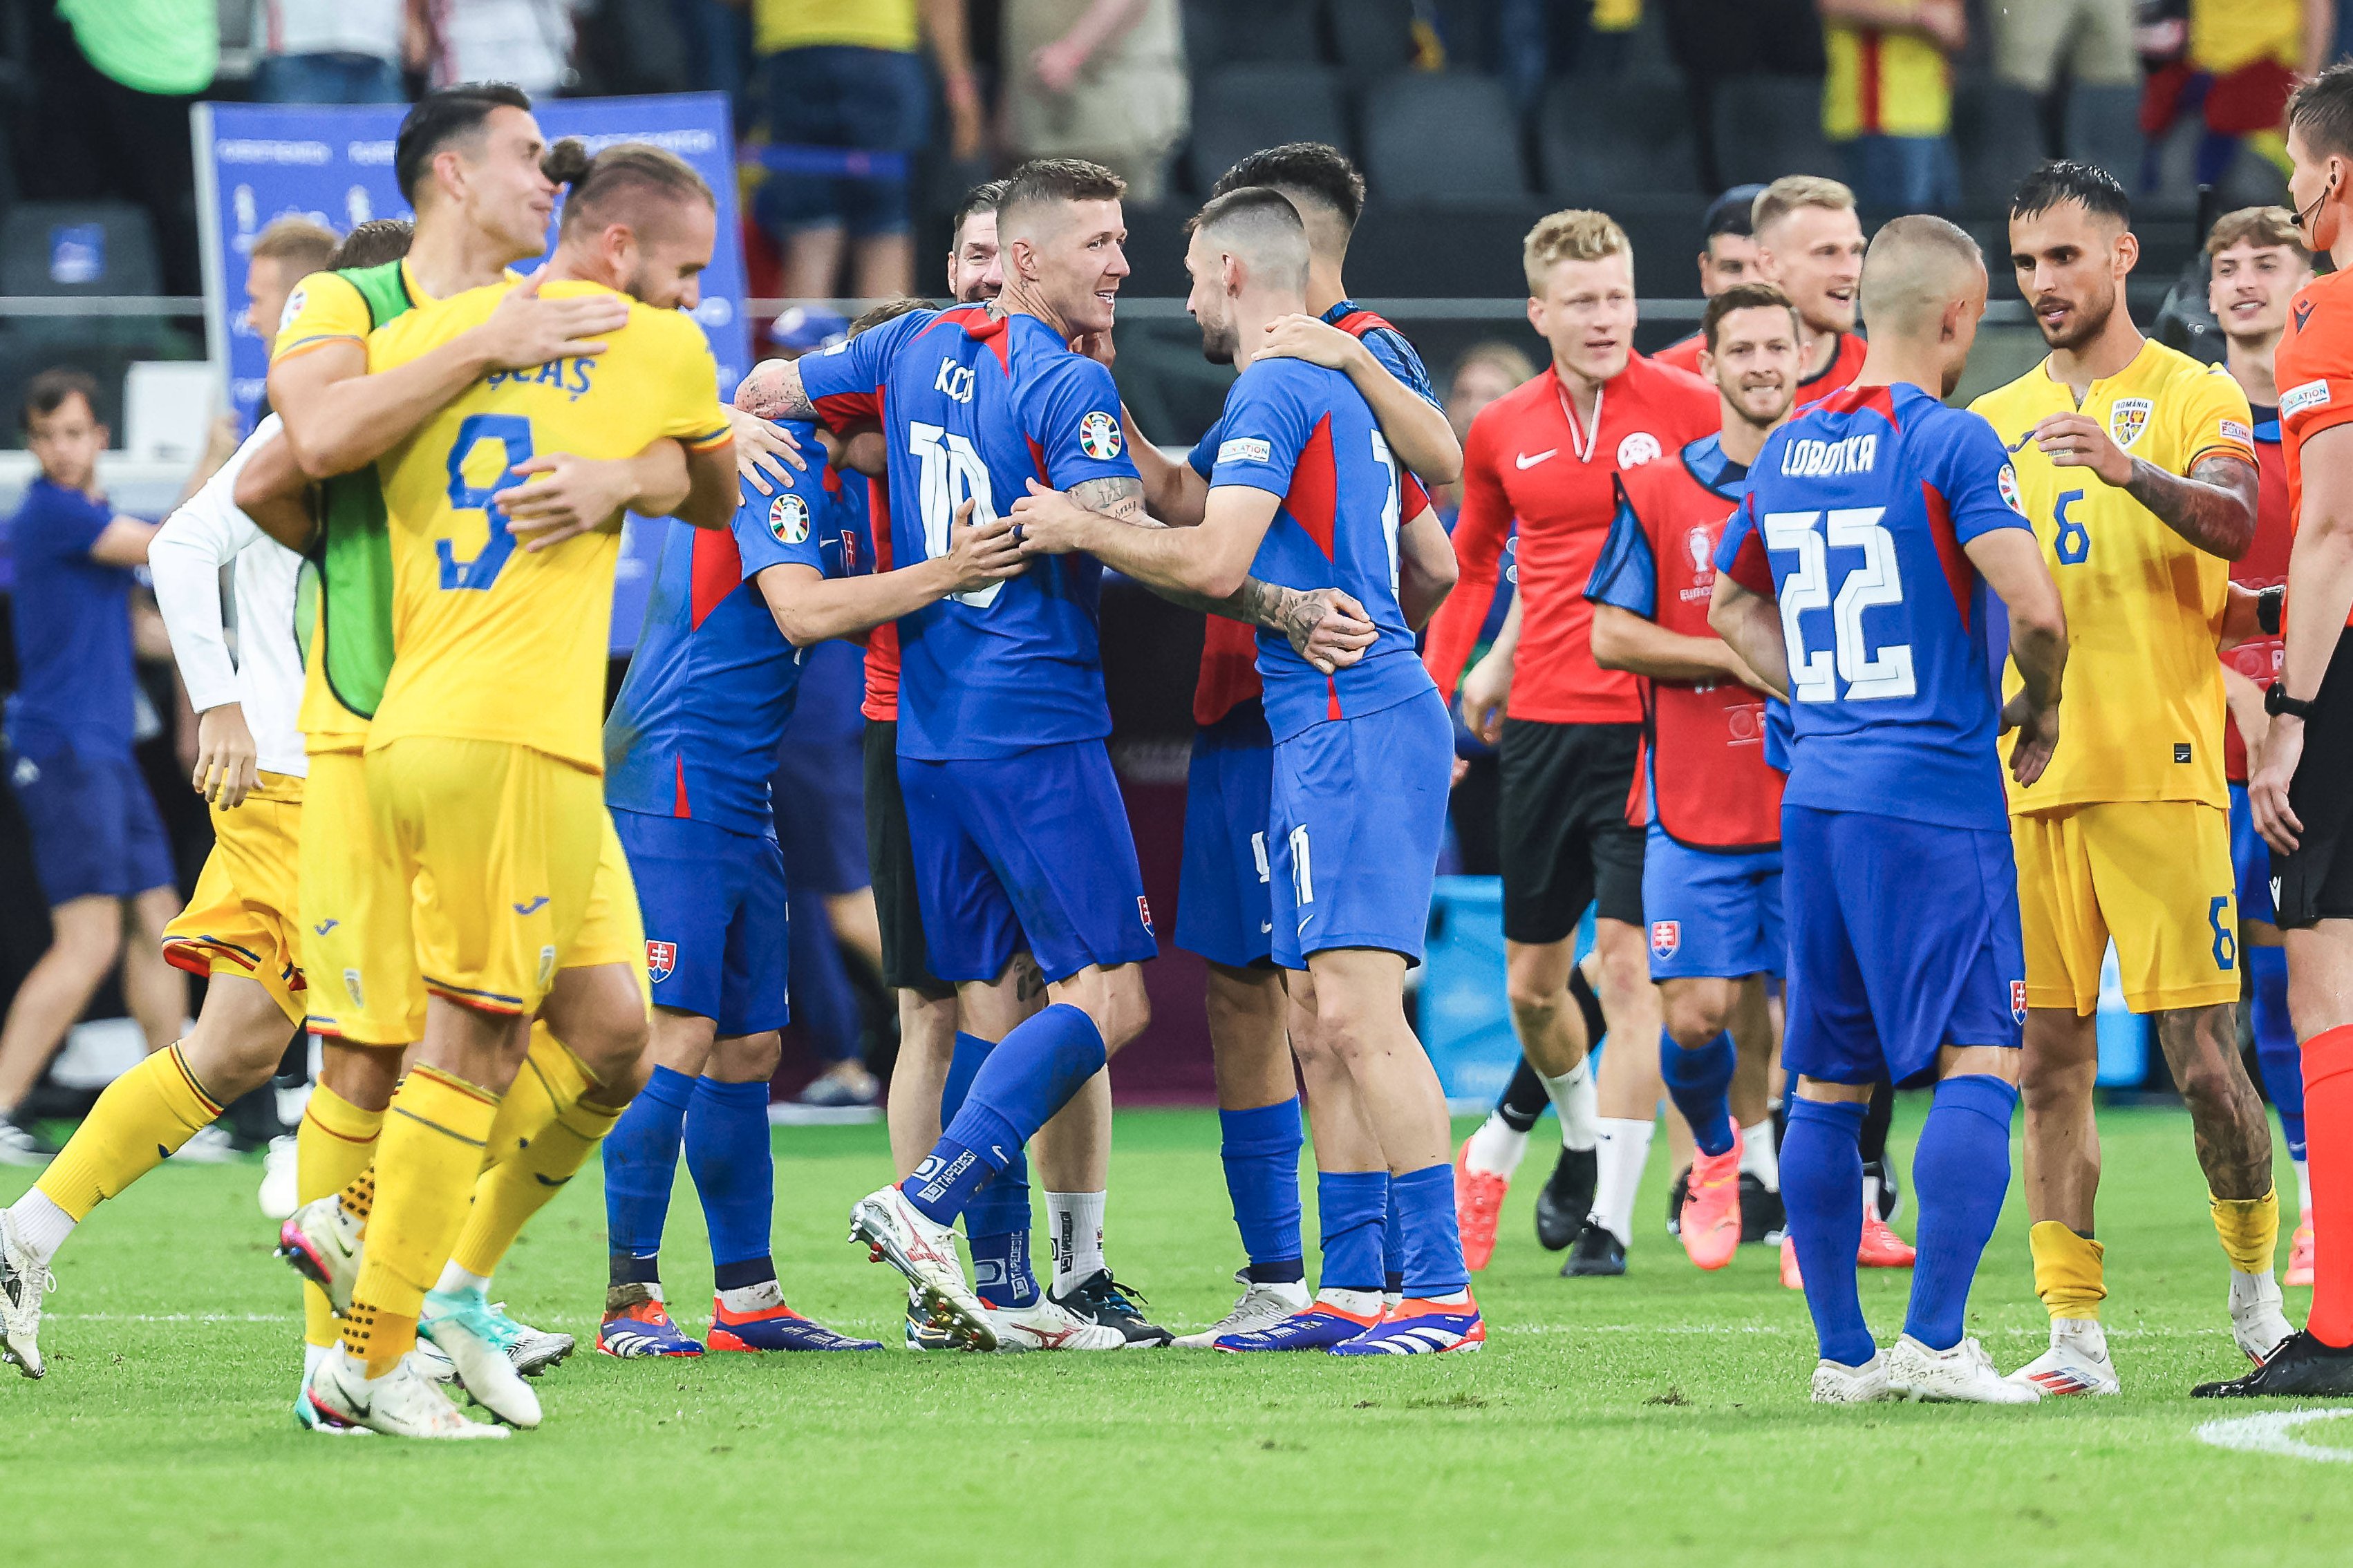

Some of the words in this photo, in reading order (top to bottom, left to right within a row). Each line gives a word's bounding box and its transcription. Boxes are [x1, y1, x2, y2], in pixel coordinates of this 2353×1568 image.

[1780, 434, 1878, 478] LOBOTKA
[434, 413, 534, 590] 9
[2053, 489, 2090, 565] 6
[1763, 506, 1918, 703] 22
[2209, 896, 2236, 970] 6
